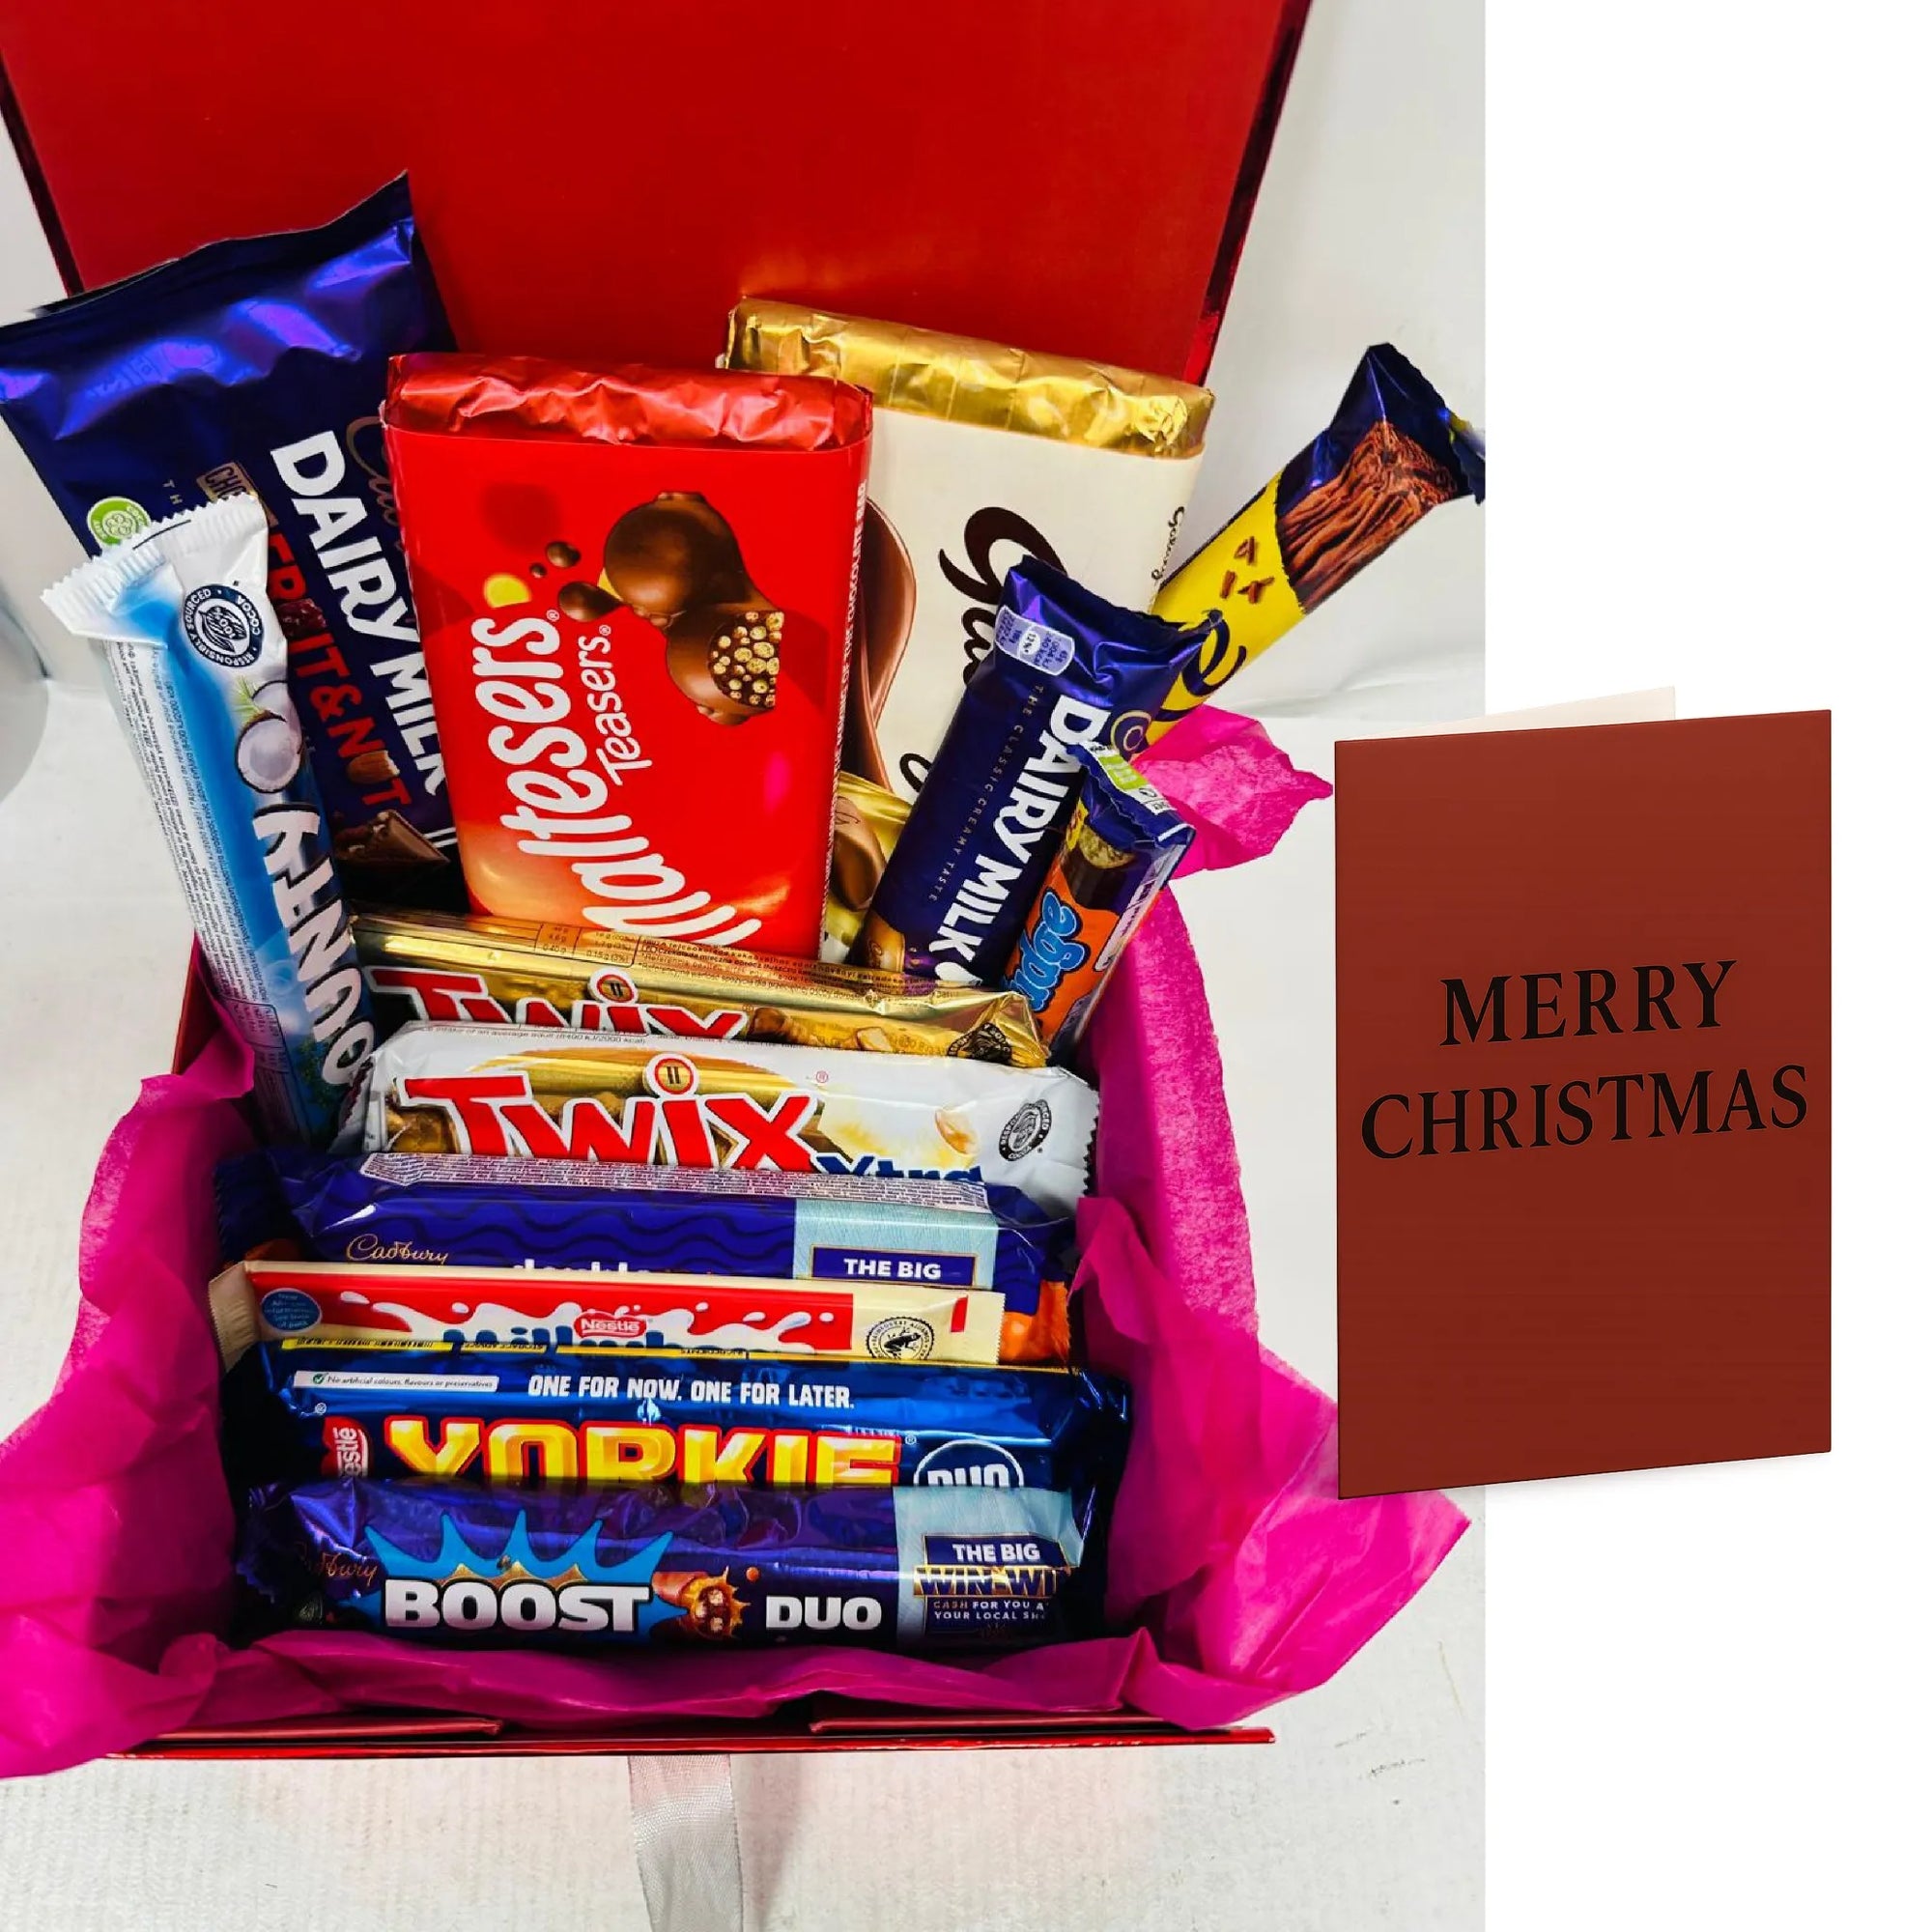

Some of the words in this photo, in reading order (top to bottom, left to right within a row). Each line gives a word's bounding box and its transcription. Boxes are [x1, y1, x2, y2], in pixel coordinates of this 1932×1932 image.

[162, 479, 183, 504] TH
[185, 588, 212, 630] SOURCED
[237, 594, 261, 636] COCOA
[270, 430, 421, 642] DAIRY
[369, 651, 446, 796] MILK
[578, 636, 653, 785] Teasers
[982, 724, 1025, 793] CLASSIC
[993, 695, 1112, 864] DAIRY
[952, 797, 988, 856] CREAMY
[928, 863, 955, 902] TASTE
[929, 854, 1023, 963] MILK
[251, 809, 376, 1085] OUNTY
[1009, 891, 1087, 1011] udge
[1439, 959, 1738, 1046] MERRY
[1361, 1064, 1808, 1159] CHRISTMAS
[346, 1234, 449, 1264] Cadbury
[843, 1259, 891, 1277] THE
[896, 1261, 942, 1281] BIG
[528, 1374, 570, 1397] ONE
[579, 1376, 619, 1399] FOR
[627, 1378, 683, 1401] NOW.
[691, 1381, 731, 1404] ONE
[740, 1382, 781, 1406] FOR
[788, 1384, 856, 1410] LATER.
[384, 1415, 902, 1486] YORKIE
[952, 1544, 996, 1562] THE
[1001, 1543, 1040, 1562] BIG
[385, 1578, 650, 1633] BOOST
[765, 1596, 882, 1631] DUO
[934, 1611, 970, 1620] YOUR
[976, 1611, 1017, 1620] LOCAL
[972, 1601, 999, 1609] FOR
[1003, 1601, 1030, 1609] YOU
